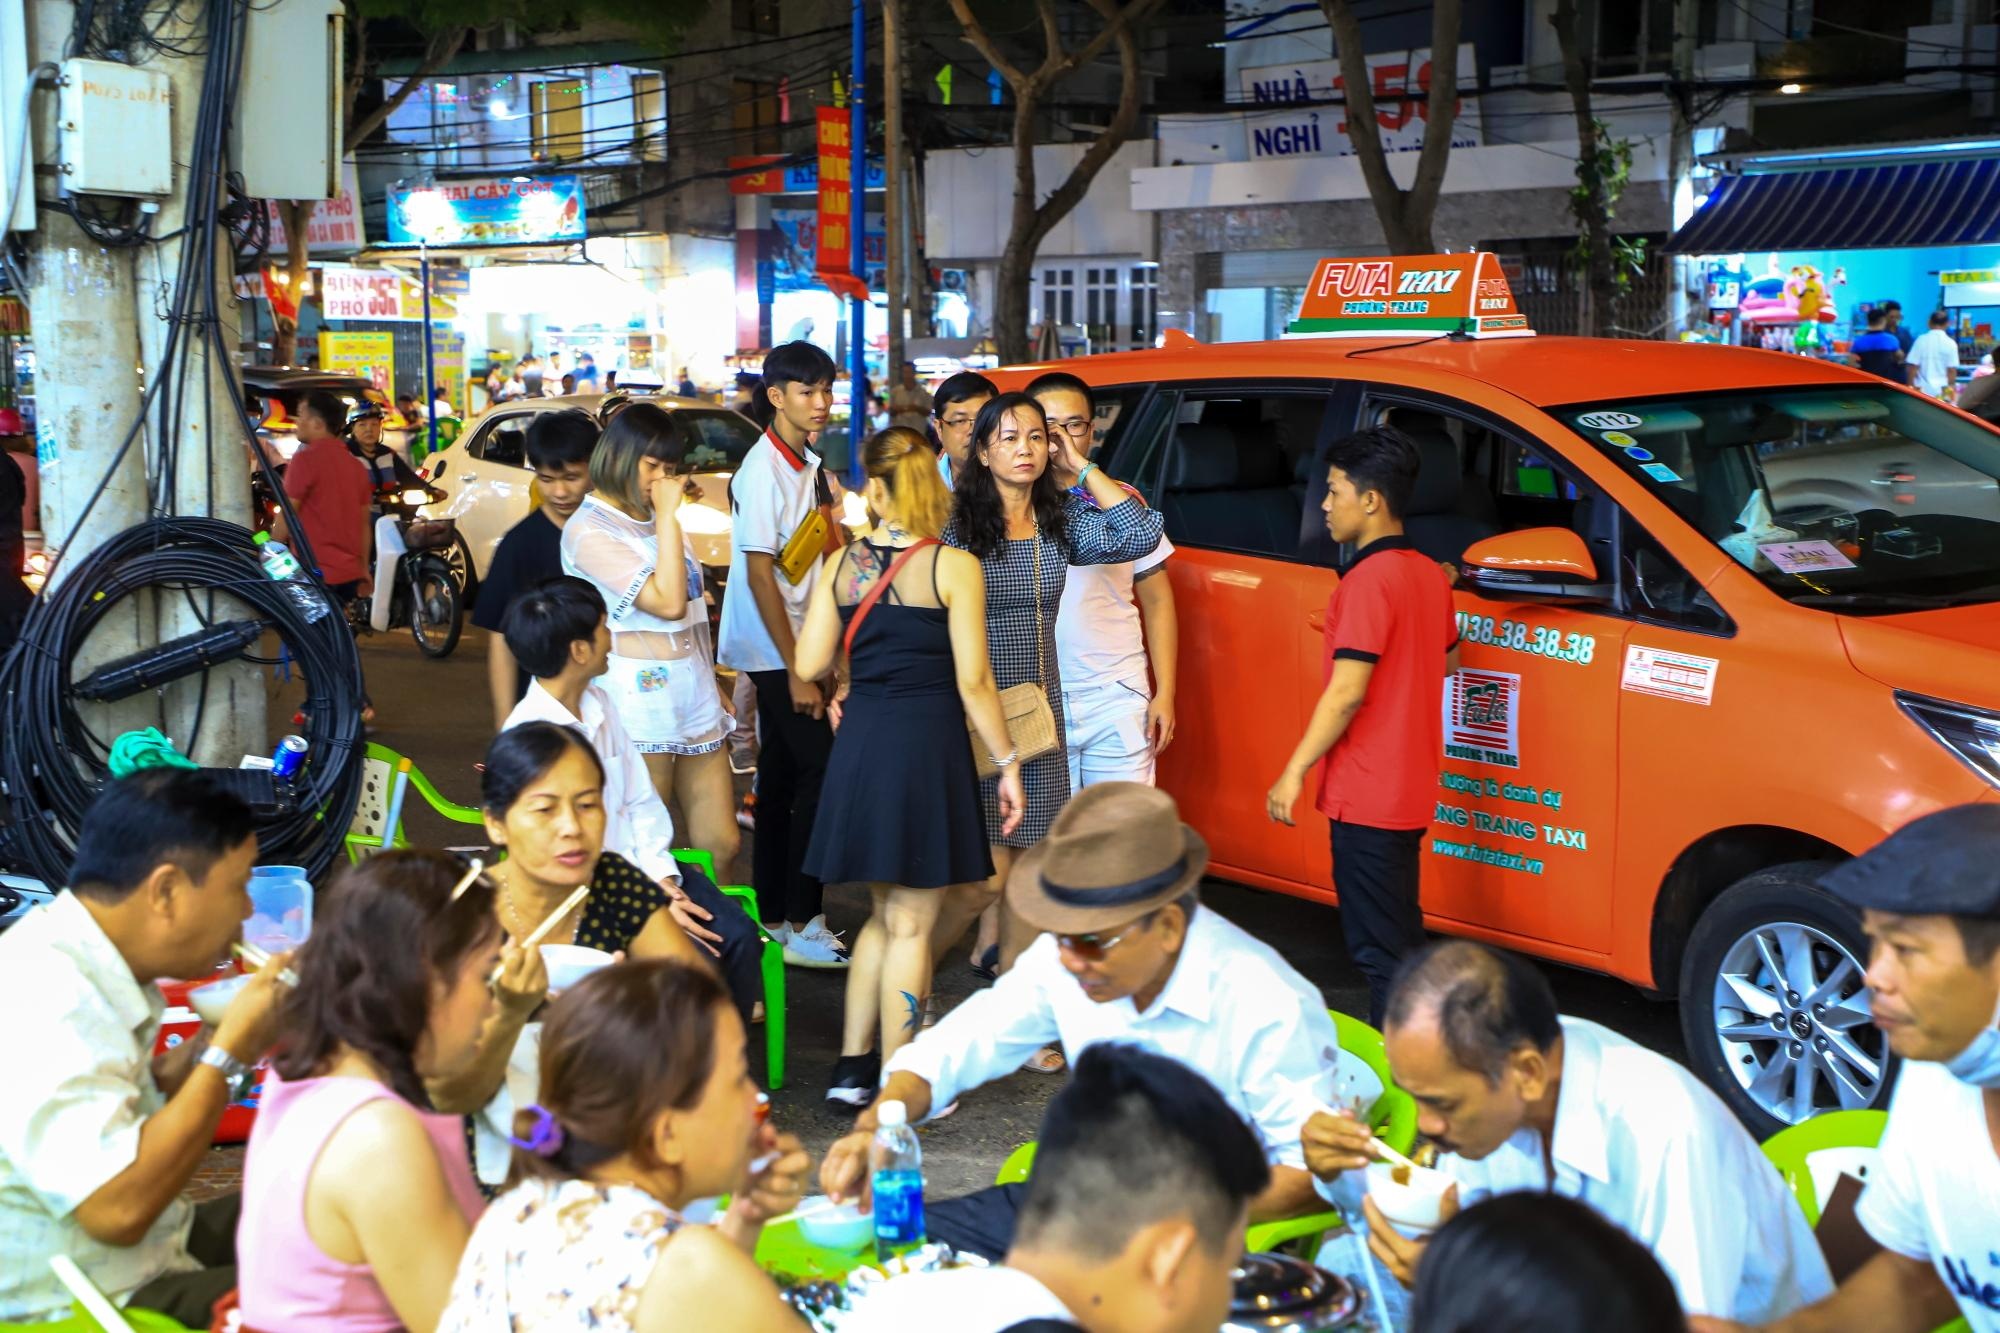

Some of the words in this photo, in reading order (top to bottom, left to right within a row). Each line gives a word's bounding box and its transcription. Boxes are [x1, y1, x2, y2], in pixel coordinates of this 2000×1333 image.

[1253, 71, 1312, 103] NHÀ
[1254, 114, 1322, 156] NGHỈ
[1317, 261, 1393, 297] FUTA
[1397, 269, 1462, 295] TAXI
[1477, 278, 1510, 297] FUTA
[1389, 300, 1429, 315] TRANG
[1479, 298, 1508, 310] TAXI
[1582, 413, 1638, 428] 0112
[1502, 781, 1539, 804] danh
[1472, 810, 1537, 841] TRANG
[1542, 825, 1587, 850] TAXI
[1432, 839, 1544, 875] www.futataxi.vn
